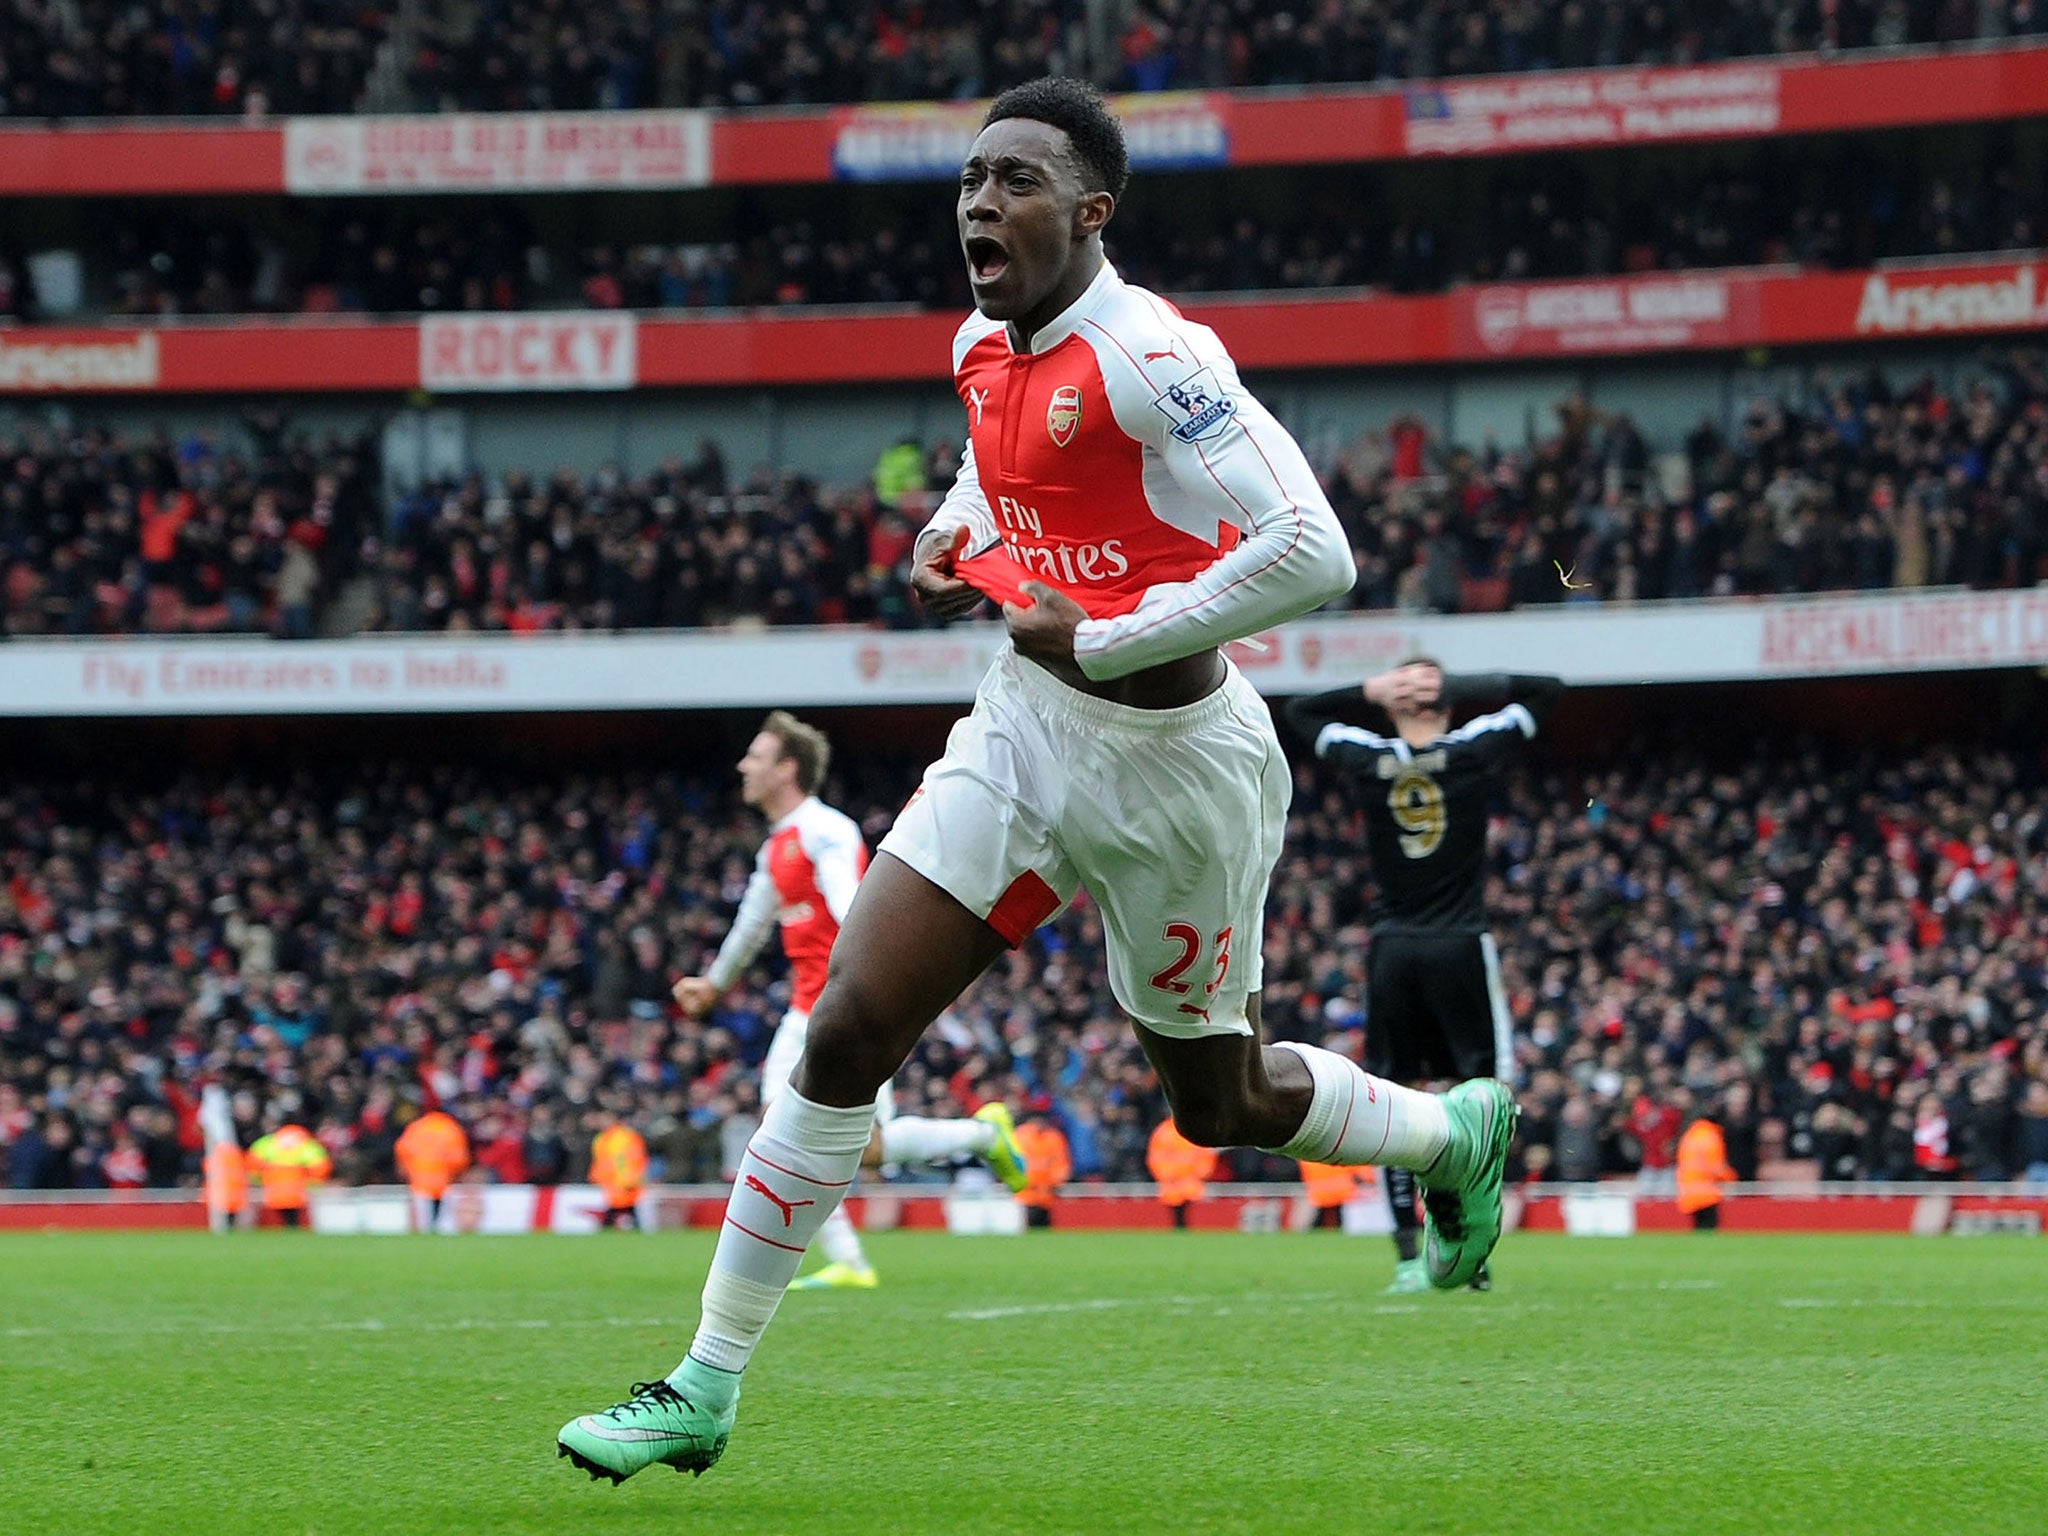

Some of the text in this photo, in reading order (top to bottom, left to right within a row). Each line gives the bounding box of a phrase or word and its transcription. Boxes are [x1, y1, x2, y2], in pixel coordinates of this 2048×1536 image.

[546, 123, 688, 151] ARSENAL
[0, 330, 158, 388] rsenal
[434, 323, 620, 375] ROCKY
[1182, 405, 1221, 435] BARCLAYS
[998, 495, 1043, 539] Fly
[1002, 532, 1128, 584] irates
[82, 649, 506, 698] Fly Emirates to India
[1386, 774, 1447, 859] 9
[1149, 922, 1234, 997] 23
